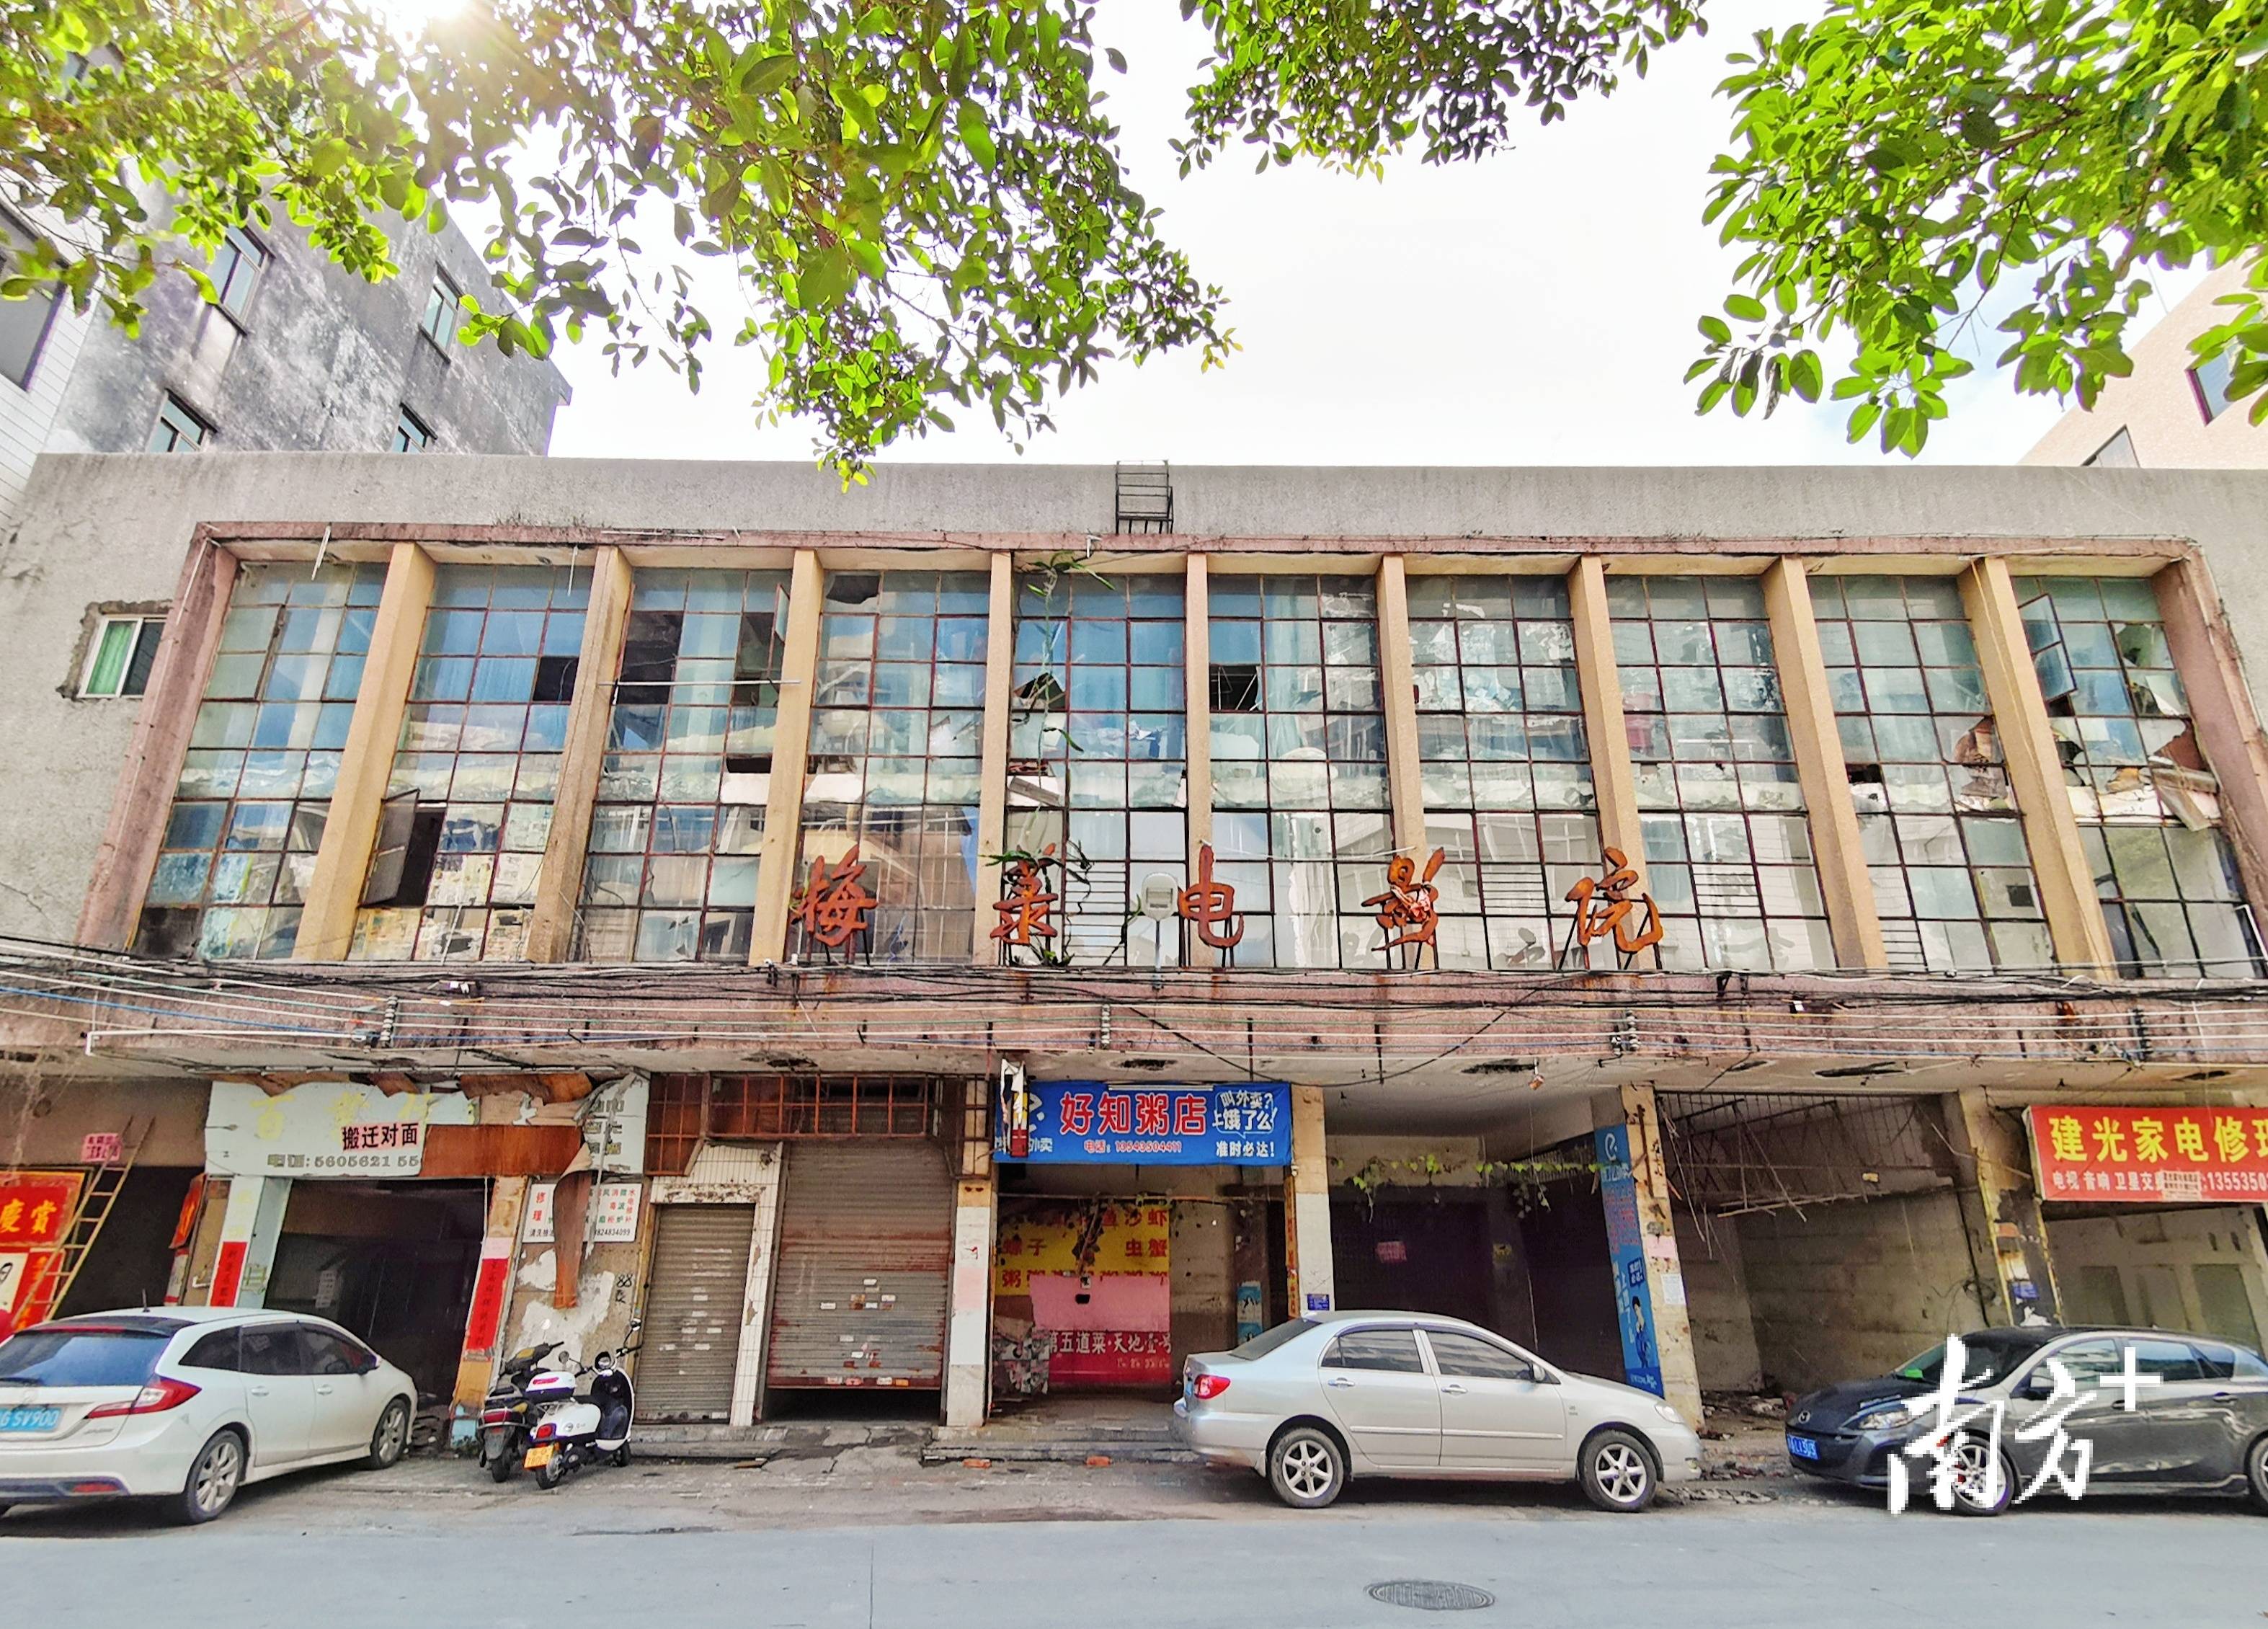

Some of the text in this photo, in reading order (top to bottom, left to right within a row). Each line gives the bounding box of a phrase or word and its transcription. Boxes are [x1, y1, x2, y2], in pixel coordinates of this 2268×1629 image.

[1059, 1091, 1207, 1136] 好知粥店
[342, 1122, 419, 1151] 搬迁对面
[1216, 1141, 1275, 1158] 准时必达!
